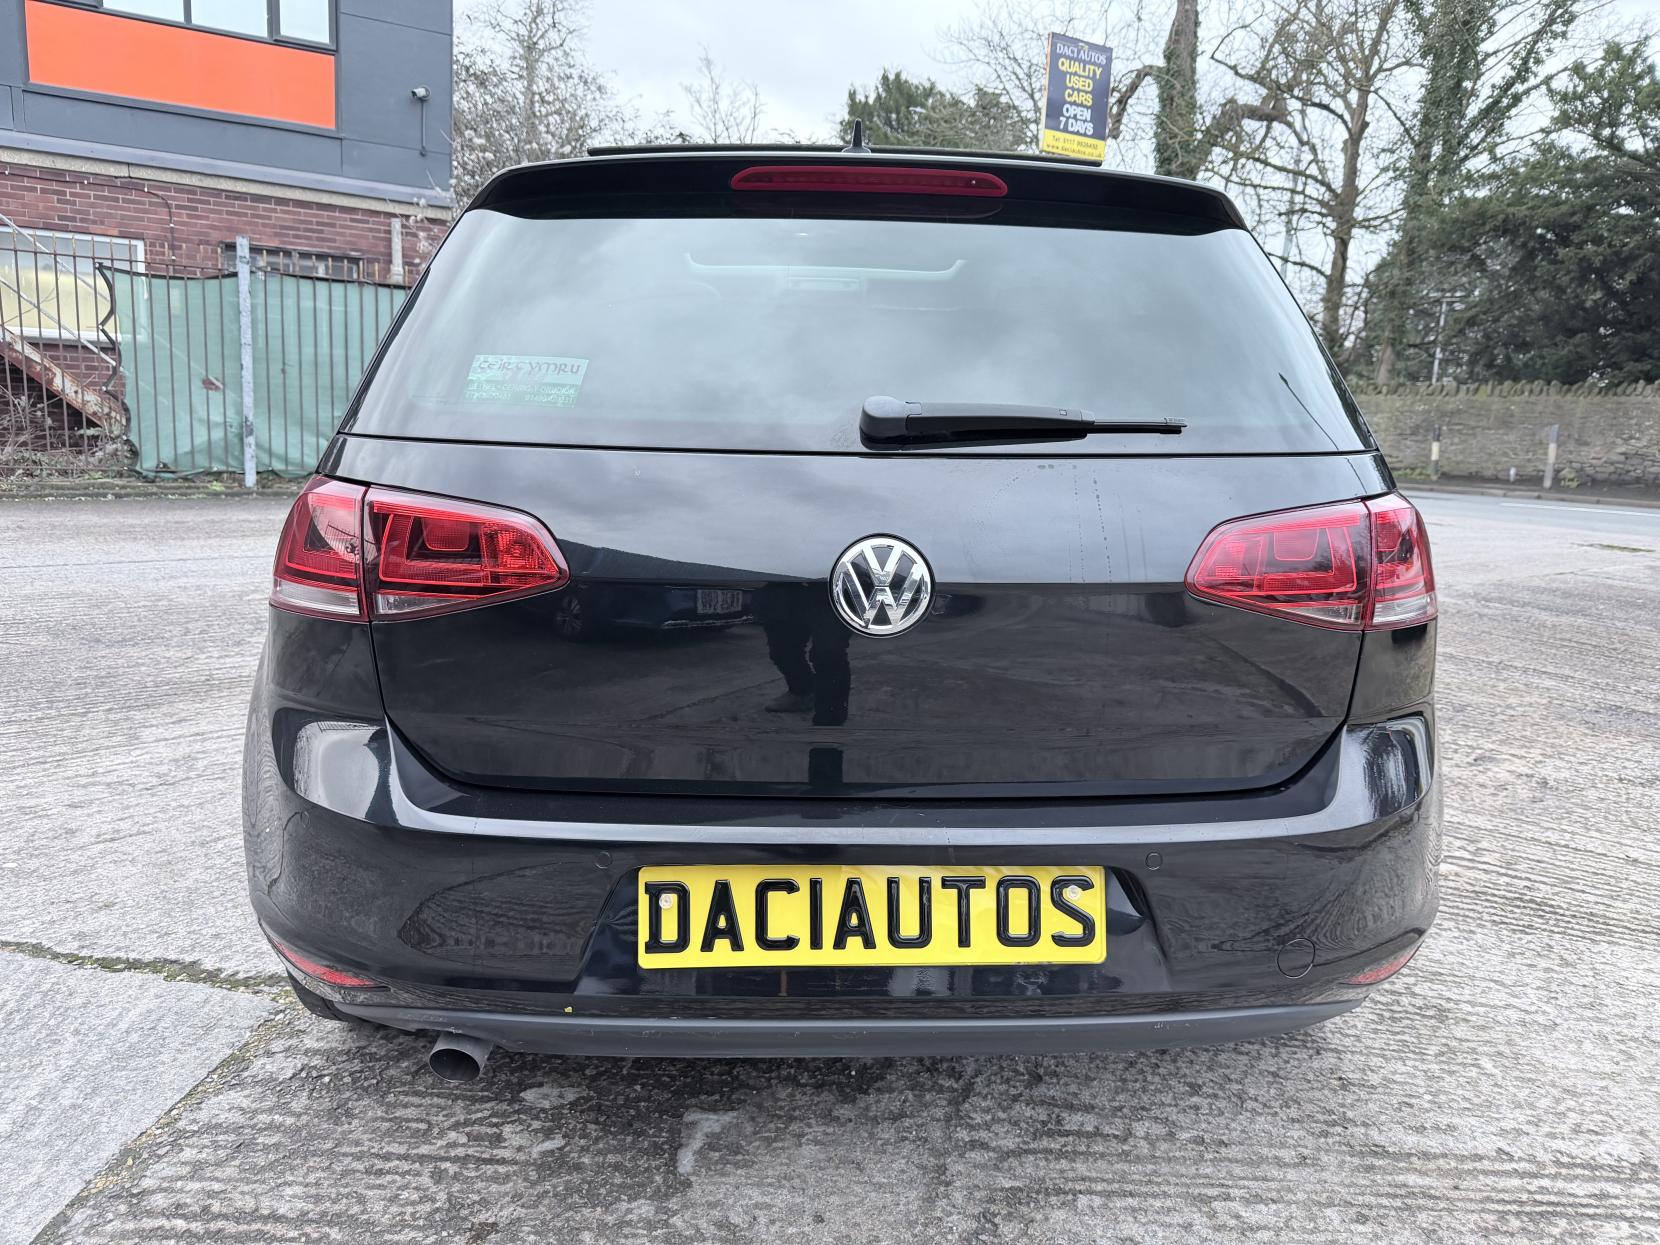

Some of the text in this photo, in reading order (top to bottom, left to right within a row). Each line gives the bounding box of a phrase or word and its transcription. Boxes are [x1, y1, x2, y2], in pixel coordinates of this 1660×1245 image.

[1056, 43, 1106, 65] DACI AUTOS
[1058, 58, 1102, 79] QUALITY
[1066, 75, 1093, 91] USED
[1065, 89, 1092, 106] CARS
[1063, 104, 1091, 121] OPEN
[1059, 117, 1093, 135] 7 DAYS
[644, 875, 1096, 954] DACIAUTOS
